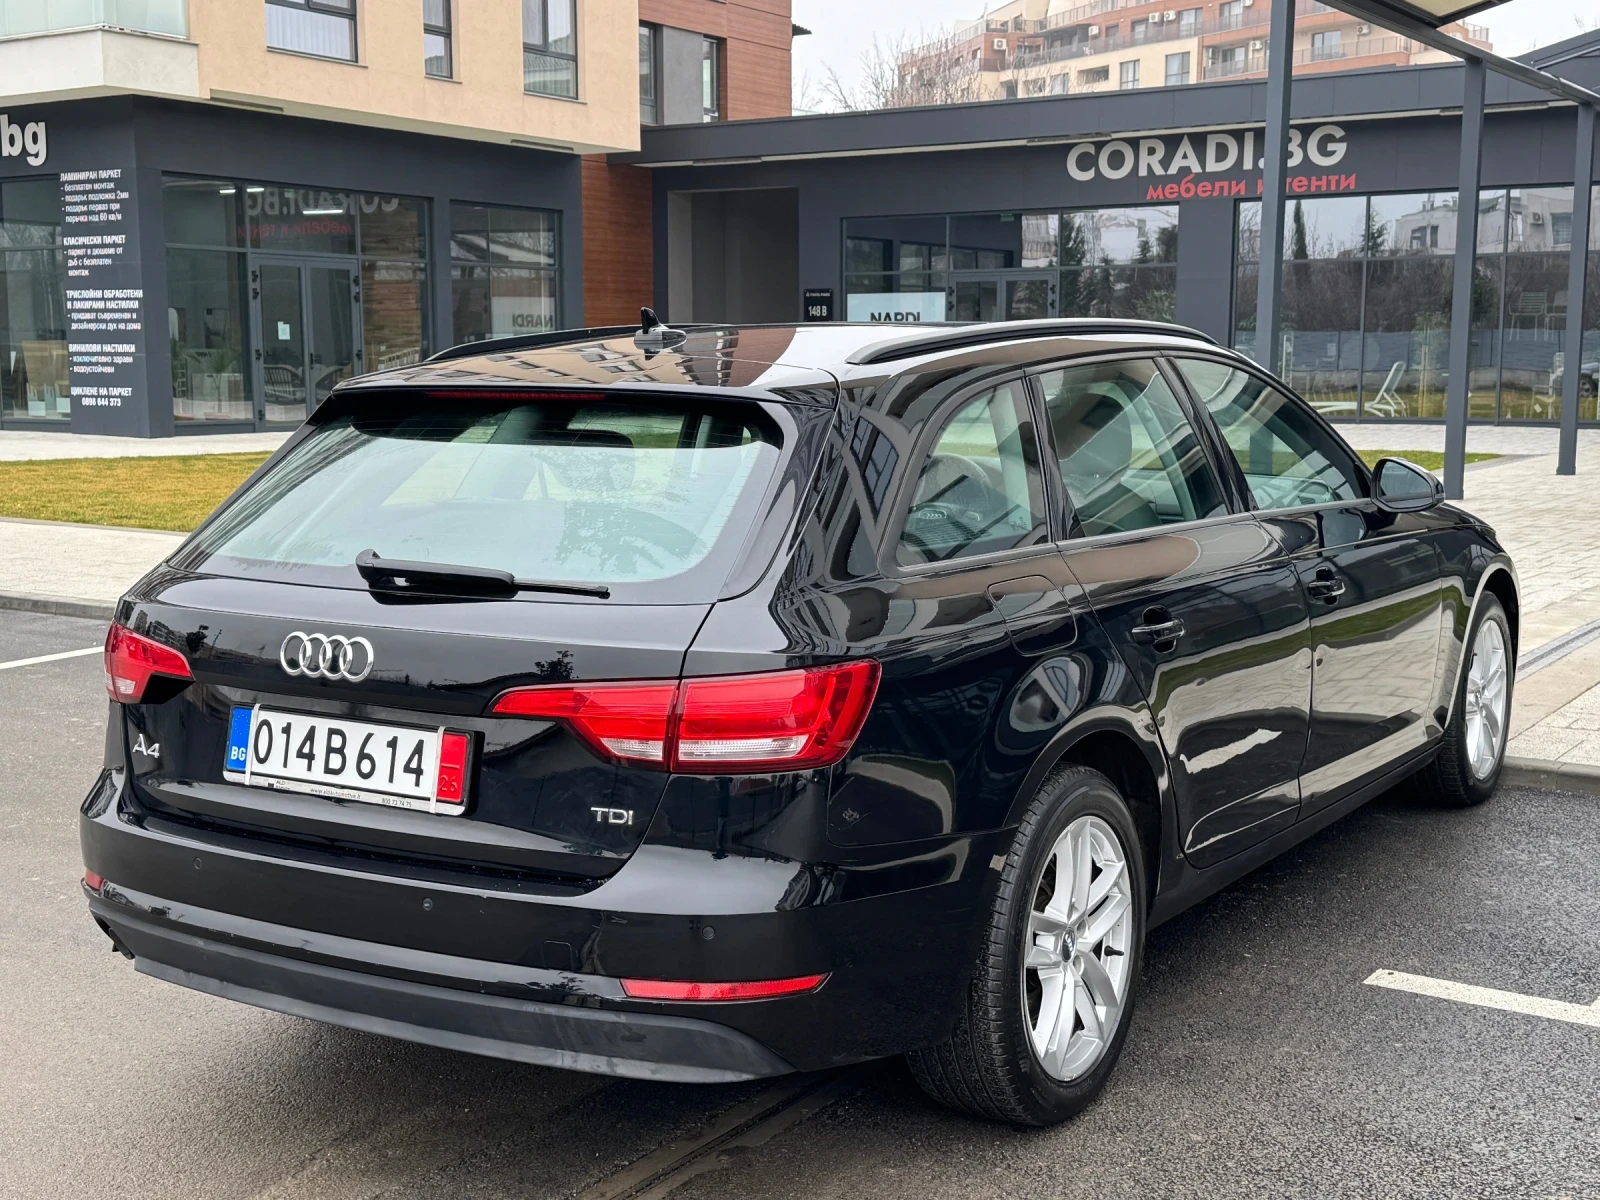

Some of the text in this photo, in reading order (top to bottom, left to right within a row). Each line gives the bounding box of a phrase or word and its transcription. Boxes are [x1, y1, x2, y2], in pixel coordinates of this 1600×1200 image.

[1066, 124, 1348, 182] CORADI.BG
[60, 169, 122, 182] ЛАМИНИРАН ПАРКЕТ
[64, 181, 115, 192] безплатен монтаж
[1146, 173, 1246, 201] мебели
[65, 190, 129, 203] подарък подложка 2мм
[65, 202, 121, 213] подарък перваз при
[65, 211, 122, 225] поръчка над 60 кв/м
[63, 234, 126, 246] КЛАСИЧЕСКИ ПАРКЕТ
[67, 248, 87, 258] паркет
[92, 247, 116, 256] дюшеме
[116, 247, 123, 255] от
[67, 257, 78, 267] дъб
[83, 257, 112, 267] безплатен
[68, 269, 90, 277] монтаж
[65, 288, 143, 299] ТРИСЛОЙНИ ОБРАБОТЕНИ
[66, 300, 139, 310] И ЛАКИРАНИ НАСТИЛКИ
[71, 312, 97, 321] придават
[97, 312, 132, 321] съвременен
[807, 305, 821, 317] 148
[71, 321, 142, 331] дизайнерски дух на дома
[68, 343, 136, 353] ВИНИЛОВИ НАСТИЛКИ
[72, 355, 134, 365] изключително здрави
[70, 386, 132, 397] ЦИКЛЕНЕ НА ПАРКЕТ
[81, 397, 121, 407] 0898 644 373
[132, 733, 160, 759] A4
[230, 746, 246, 761] BG
[253, 718, 425, 788] 014B614
[439, 774, 458, 792] 26
[590, 806, 634, 826] TDI
